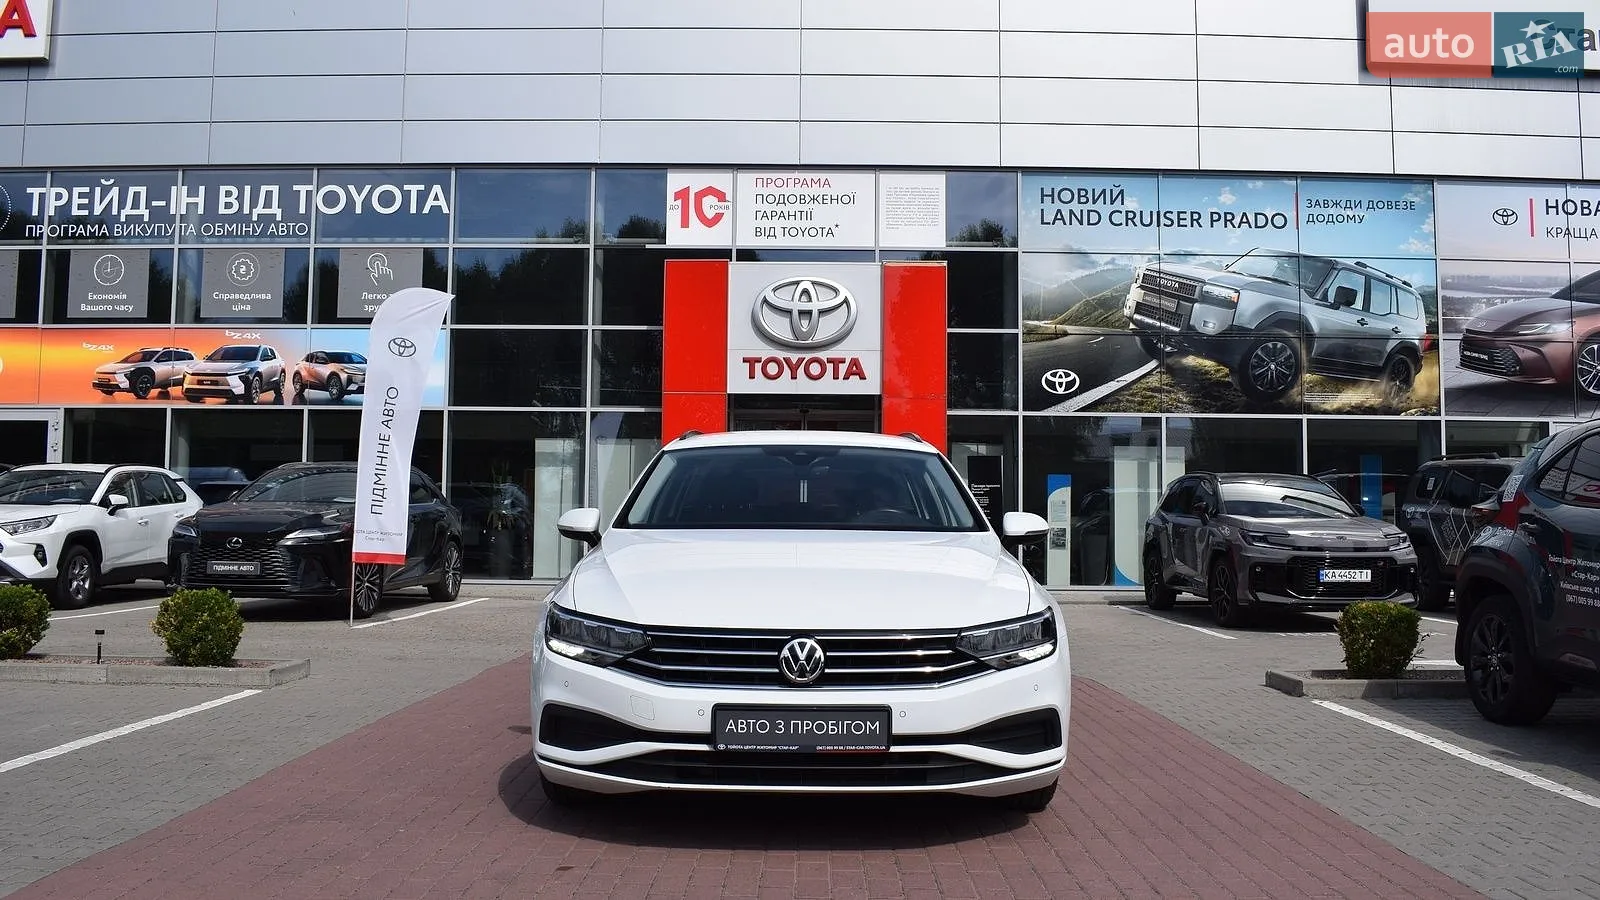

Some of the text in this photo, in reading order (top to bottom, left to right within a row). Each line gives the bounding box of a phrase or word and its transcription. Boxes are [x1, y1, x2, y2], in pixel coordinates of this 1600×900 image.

[755, 177, 831, 188] ПРОГРАМА
[26, 178, 450, 222] ТРЕЙД-ІН ВІД TOYOTA
[755, 191, 857, 206] ПОДОВЖЕНОЇ
[1040, 184, 1125, 206] НОВИЙ
[1306, 199, 1416, 211] ЗАВЖДИ ДОВЕЗЕ
[755, 209, 813, 221] ГАРАНТІЇ
[1040, 208, 1288, 230] LAND CRUISER PRADO
[1306, 213, 1366, 225] ДОДОМУ
[25, 222, 309, 237] ПРОГРАМА ВИКУПУ ТА ОБМІНУ АВТО
[755, 227, 777, 240] ВІД
[1546, 226, 1599, 241] КРАЩА
[88, 292, 127, 300] Економія
[213, 291, 272, 301] Справедлива
[361, 292, 388, 300] Легко
[114, 304, 133, 313] часу
[232, 303, 251, 312] ціна
[363, 304, 380, 313] зру
[742, 356, 867, 380] TOYOTA
[370, 386, 399, 515] ПІДМІННЕ АВТО
[1324, 571, 1336, 579] KA
[1337, 571, 1357, 579] 4452
[725, 719, 880, 735] АВТО З ПРОБІГОМ
